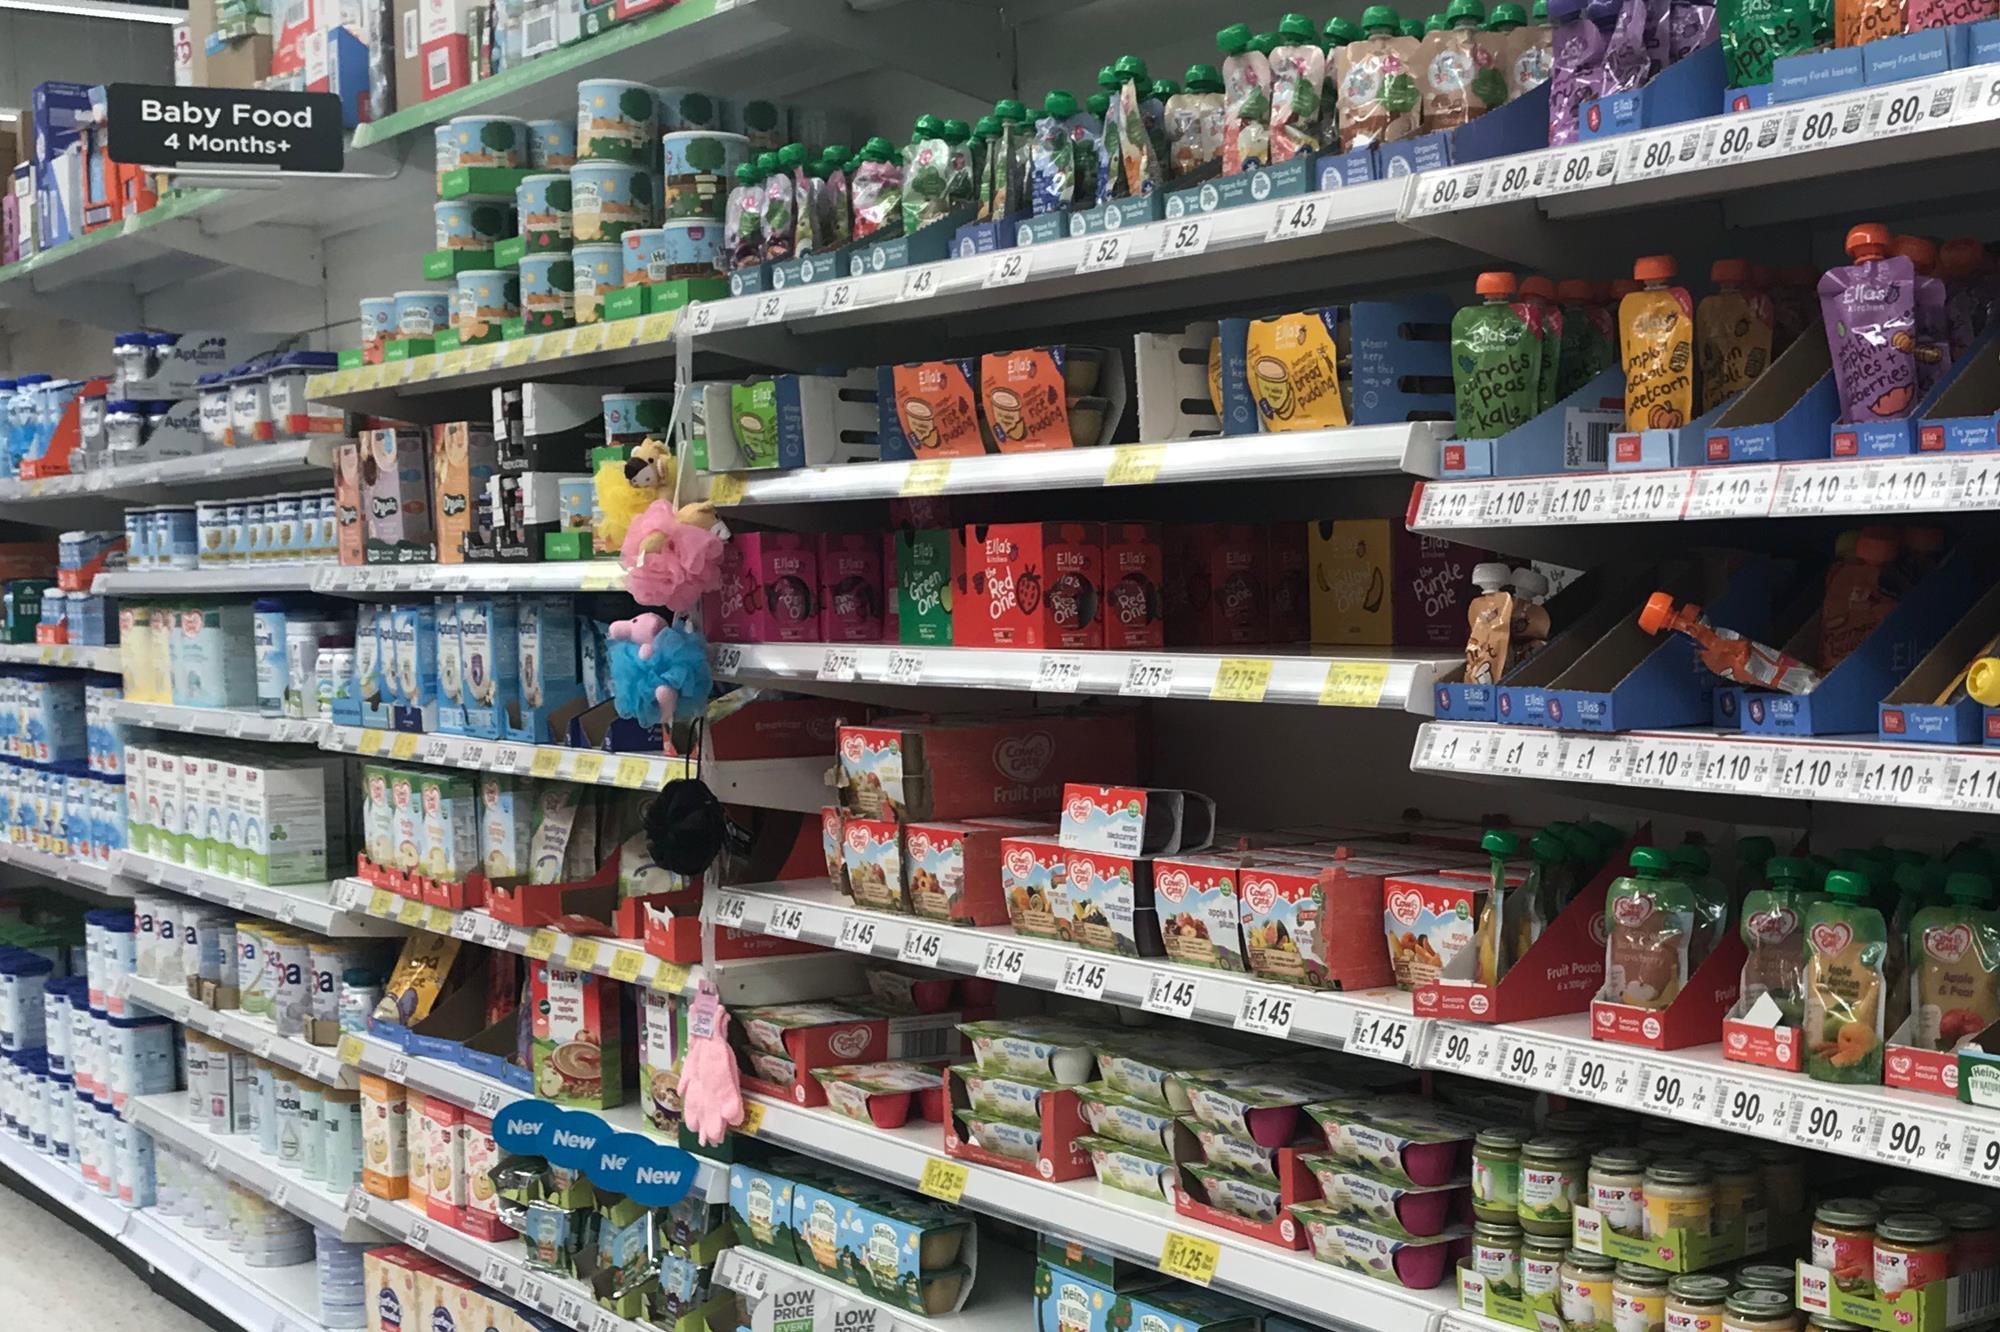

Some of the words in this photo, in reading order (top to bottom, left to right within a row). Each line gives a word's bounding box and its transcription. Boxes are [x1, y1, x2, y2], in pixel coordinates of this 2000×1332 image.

[1934, 87, 1957, 99] LOW
[141, 99, 222, 129] Baby
[232, 103, 313, 131] Food
[1886, 95, 1925, 127] 80p
[1802, 111, 1839, 142] 80p
[164, 132, 180, 150] 4
[188, 133, 292, 155] Months+
[1720, 126, 1753, 156] 80p
[1643, 140, 1675, 169] 80p
[1502, 165, 1530, 192] 80p
[1563, 155, 1592, 183] 80p
[1432, 178, 1460, 204] 80p
[1290, 203, 1317, 228] 43p
[1842, 281, 1887, 305] Ella's
[1360, 339, 1389, 353] please
[1007, 358, 1033, 376] Ella's
[1362, 353, 1384, 367] keep
[1362, 367, 1374, 376] me
[1376, 365, 1395, 377] this
[918, 369, 942, 386] Ella's
[1294, 365, 1323, 392] bread
[1361, 378, 1380, 390] way
[1381, 377, 1392, 390] up
[1463, 352, 1530, 396] carrots
[1298, 375, 1339, 410] pudding
[1479, 375, 1527, 404] peas
[1620, 484, 1665, 511] £1.10
[1791, 475, 1841, 505] £1.10
[1875, 470, 1928, 501] £1.10
[1486, 491, 1526, 516] £1.10
[1551, 487, 1592, 514] £1.10
[913, 541, 935, 558] Ella's
[985, 537, 1014, 556] Ella's
[1119, 551, 1148, 567] Ella's
[773, 557, 800, 571] Ella's
[1056, 551, 1085, 568] Ella's
[985, 567, 998, 579] the
[988, 565, 1016, 598] Red
[1412, 560, 1464, 602] Purple
[909, 570, 943, 602] Green
[917, 591, 941, 617] One
[989, 588, 1019, 620] One
[1118, 586, 1148, 613] Red
[1425, 588, 1457, 617] One
[1120, 604, 1149, 623] One
[1133, 666, 1163, 687] £2.75
[1441, 737, 1460, 762] £1
[1506, 741, 1525, 766] £1
[1576, 745, 1596, 770] £1
[1635, 749, 1679, 777] £1.10
[1705, 753, 1752, 782] £1.10
[1783, 757, 1832, 787] £1.10
[1863, 762, 1914, 793] £1.10
[1916, 775, 1934, 786] FOR
[1956, 769, 2000, 800] £1.1
[774, 907, 803, 932] £1.45
[1208, 907, 1227, 920] apple
[844, 921, 876, 947] £1.45
[907, 934, 941, 959] £1.45
[988, 947, 1024, 973] £1.45
[551, 969, 578, 983] HiPP
[1068, 961, 1107, 991] £1.45
[1546, 965, 1570, 981] Fruit
[1156, 977, 1194, 1008] £1.45
[1249, 997, 1293, 1028] £1.45
[1359, 1017, 1408, 1051] £1.45
[1445, 1034, 1471, 1065] 90p
[1510, 1046, 1538, 1076] 90p
[1578, 1060, 1608, 1092] 90p
[1971, 1067, 1999, 1085] Heinz
[1653, 1075, 1684, 1108] 90p
[1691, 1091, 1706, 1103] FOR
[1731, 1090, 1765, 1125] 90p
[1808, 1106, 1842, 1142] 90p
[1850, 1124, 1866, 1136] FOR
[552, 1129, 597, 1151] New
[1889, 1121, 1925, 1158] 90p
[1934, 1140, 1952, 1153] FOR
[600, 1153, 630, 1171] Ne
[636, 1166, 682, 1186] New
[931, 1166, 954, 1192] £1.25
[1528, 1172, 1556, 1186] HiPP
[1597, 1188, 1625, 1202] HiPP
[1577, 1216, 1600, 1233] HiPP
[1335, 1226, 1374, 1250] Blueberry
[1172, 1247, 1203, 1273] £1.25
[1480, 1249, 1506, 1265] HiPP
[1873, 1251, 1900, 1270] HiPP
[1527, 1262, 1553, 1279] HiPP
[1062, 1286, 1089, 1308] Heinz
[1463, 1280, 1483, 1296] HiPP
[1802, 1276, 1827, 1294] HiPP
[774, 1288, 816, 1309] LOW
[773, 1304, 815, 1322] PRICE
[834, 1307, 878, 1328] LOW
[1666, 1310, 1692, 1326] HiPP
